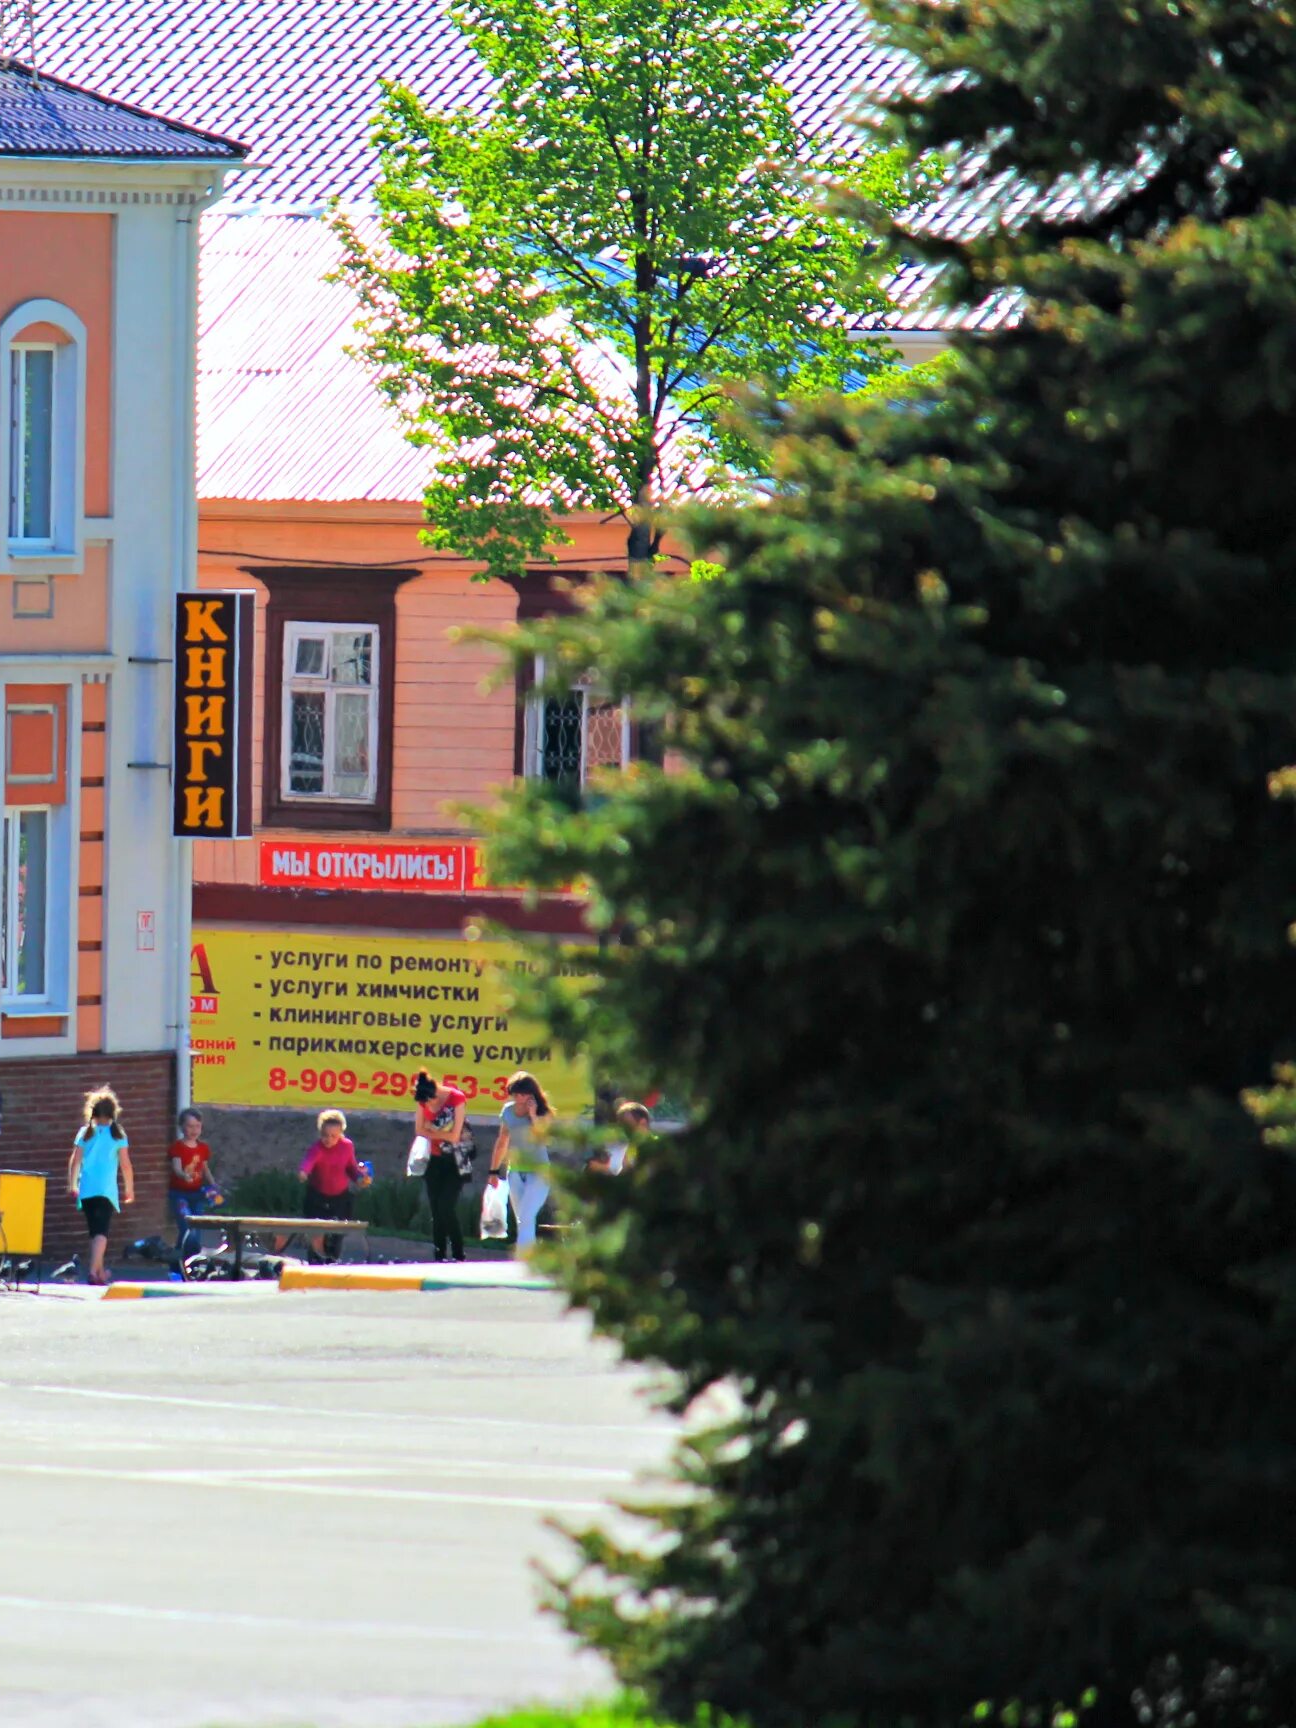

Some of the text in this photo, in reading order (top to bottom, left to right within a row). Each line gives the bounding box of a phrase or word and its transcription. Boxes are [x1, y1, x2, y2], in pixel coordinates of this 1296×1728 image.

[183, 600, 228, 828] КНИГИ
[272, 850, 309, 876] МЫ
[317, 852, 454, 880] ОТКРЫЛИСЬ!
[270, 951, 348, 971] услуги
[357, 955, 382, 969] по
[390, 956, 483, 977] ремонту
[270, 979, 480, 1002] услуги химчистки
[269, 1007, 508, 1035] клининговые услуги
[268, 1036, 552, 1064] парикмахерские услуги
